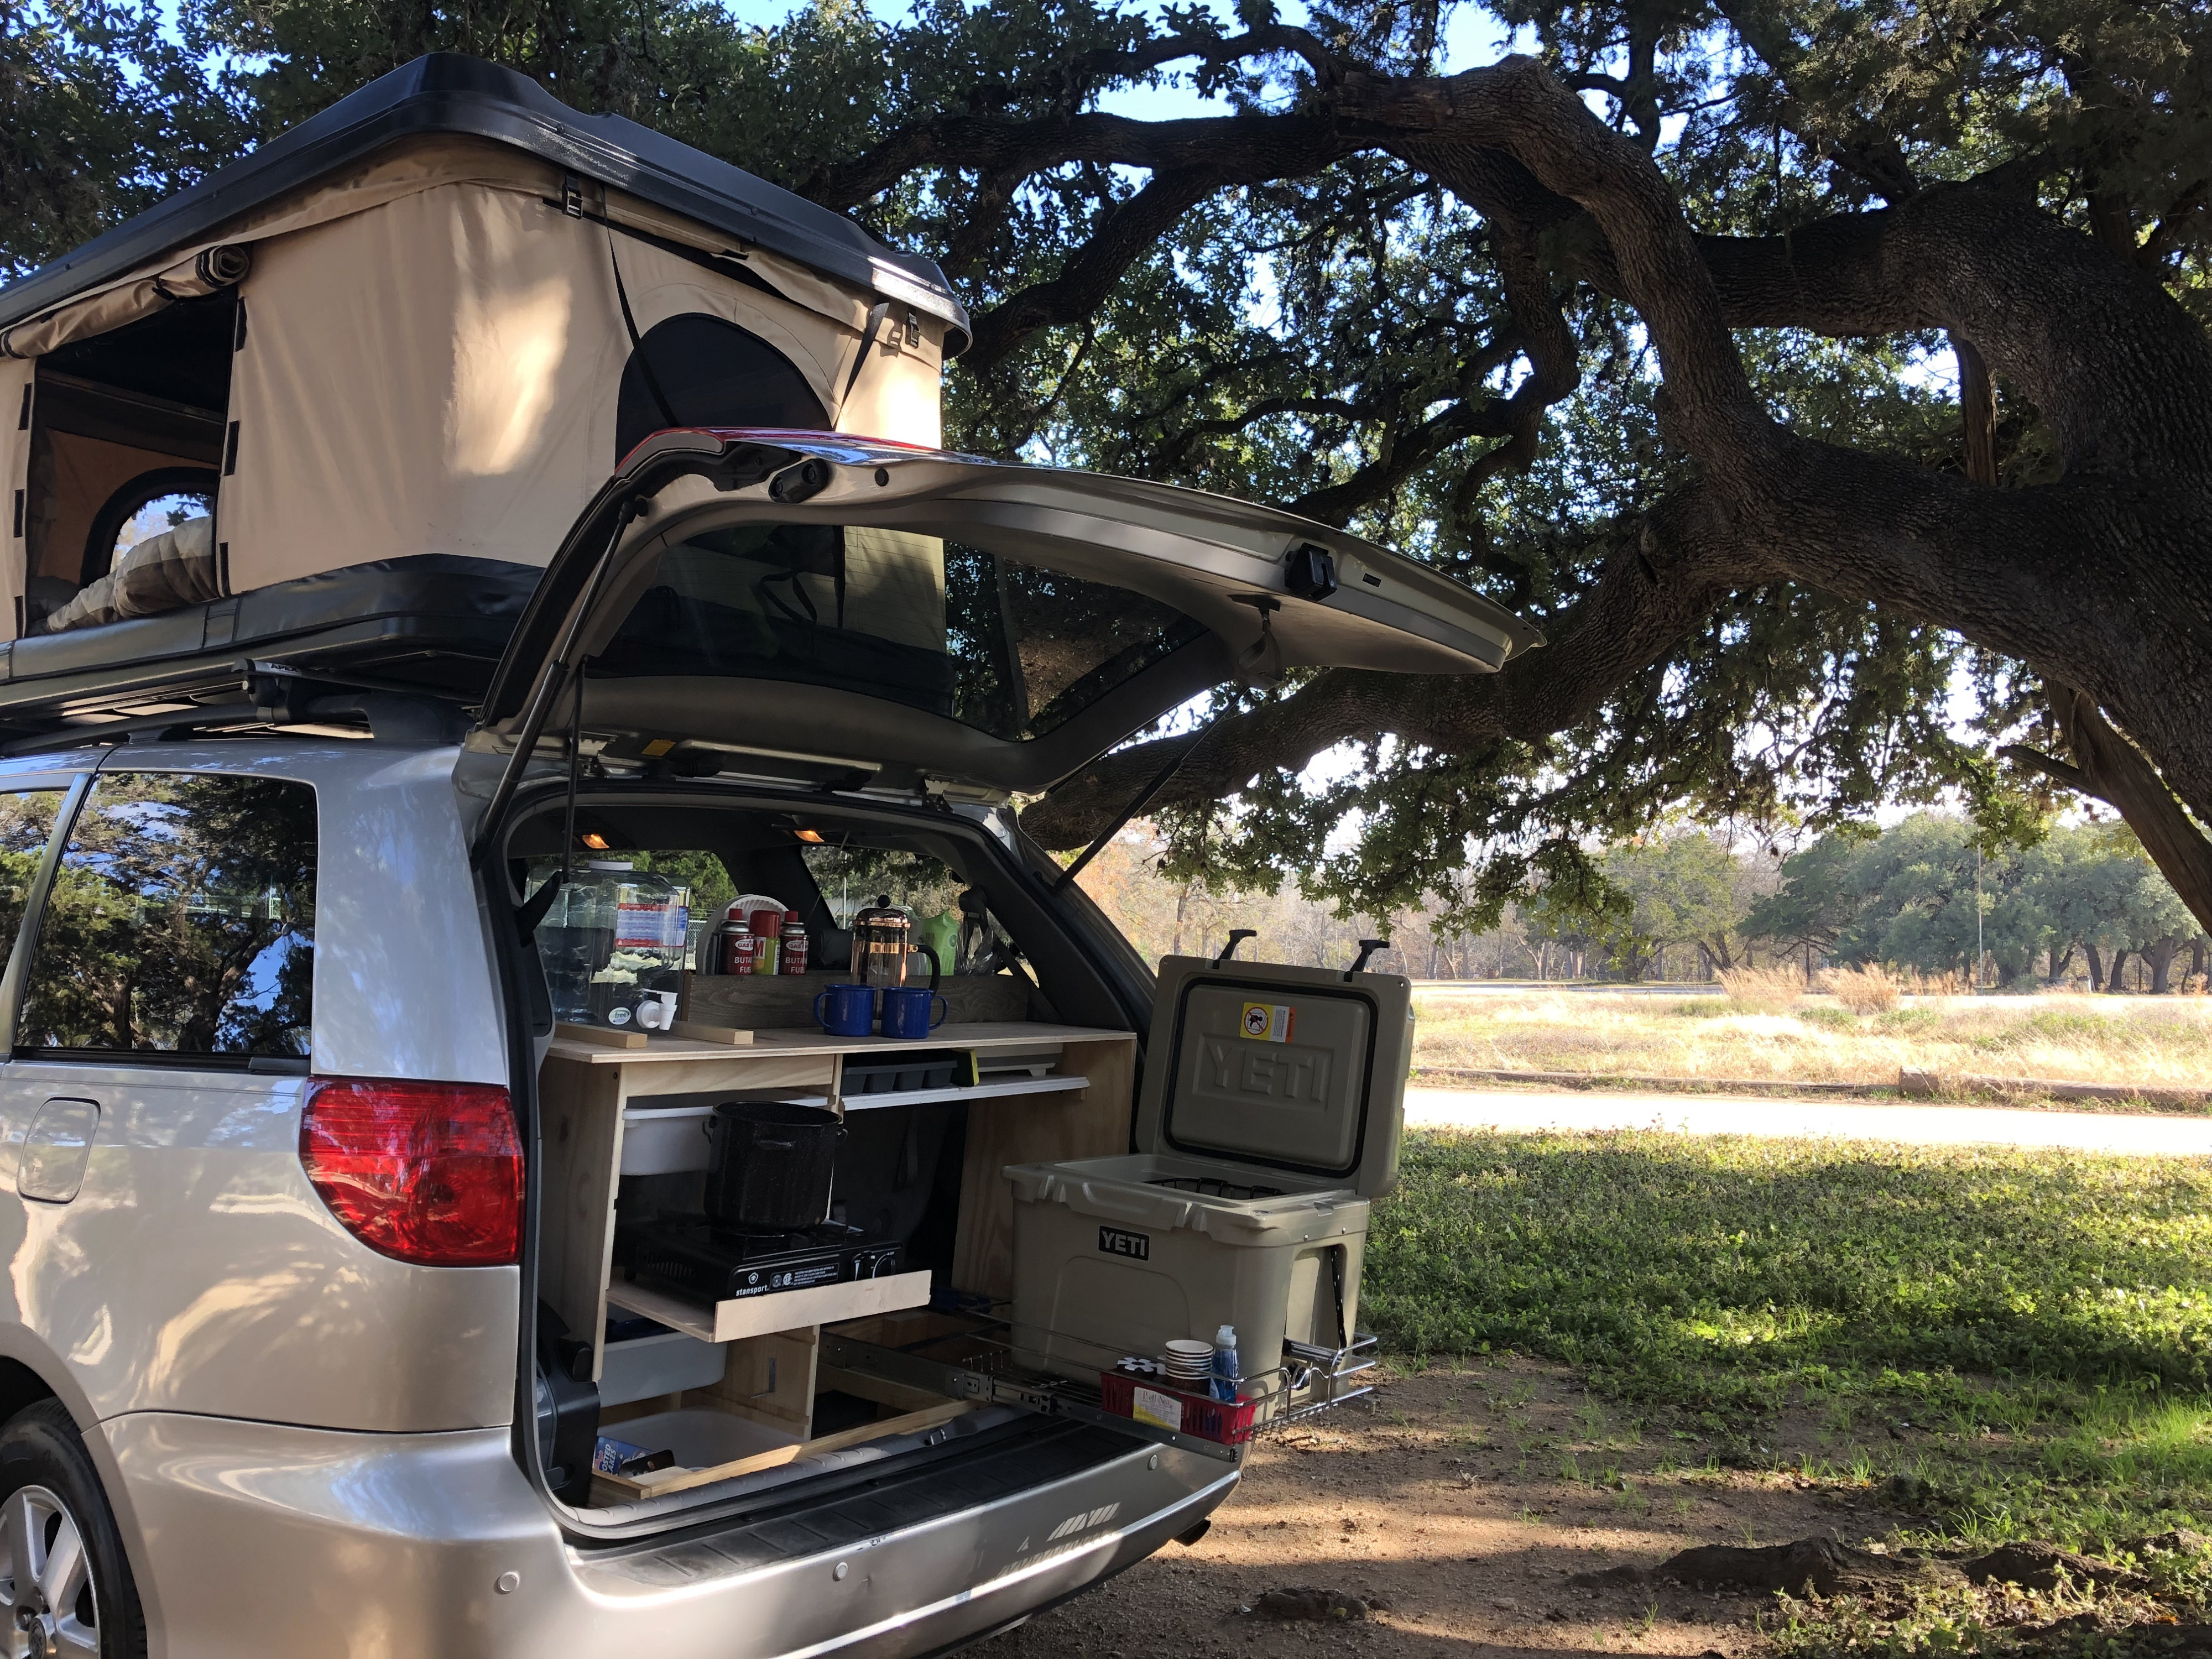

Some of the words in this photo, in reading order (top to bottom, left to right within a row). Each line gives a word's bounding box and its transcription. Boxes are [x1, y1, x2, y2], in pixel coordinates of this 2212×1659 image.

[1206, 1043, 1327, 1102] YETI
[1102, 1230, 1145, 1256] YETI
[602, 1443, 611, 1472] OSTED
[608, 1449, 617, 1474] AKES
